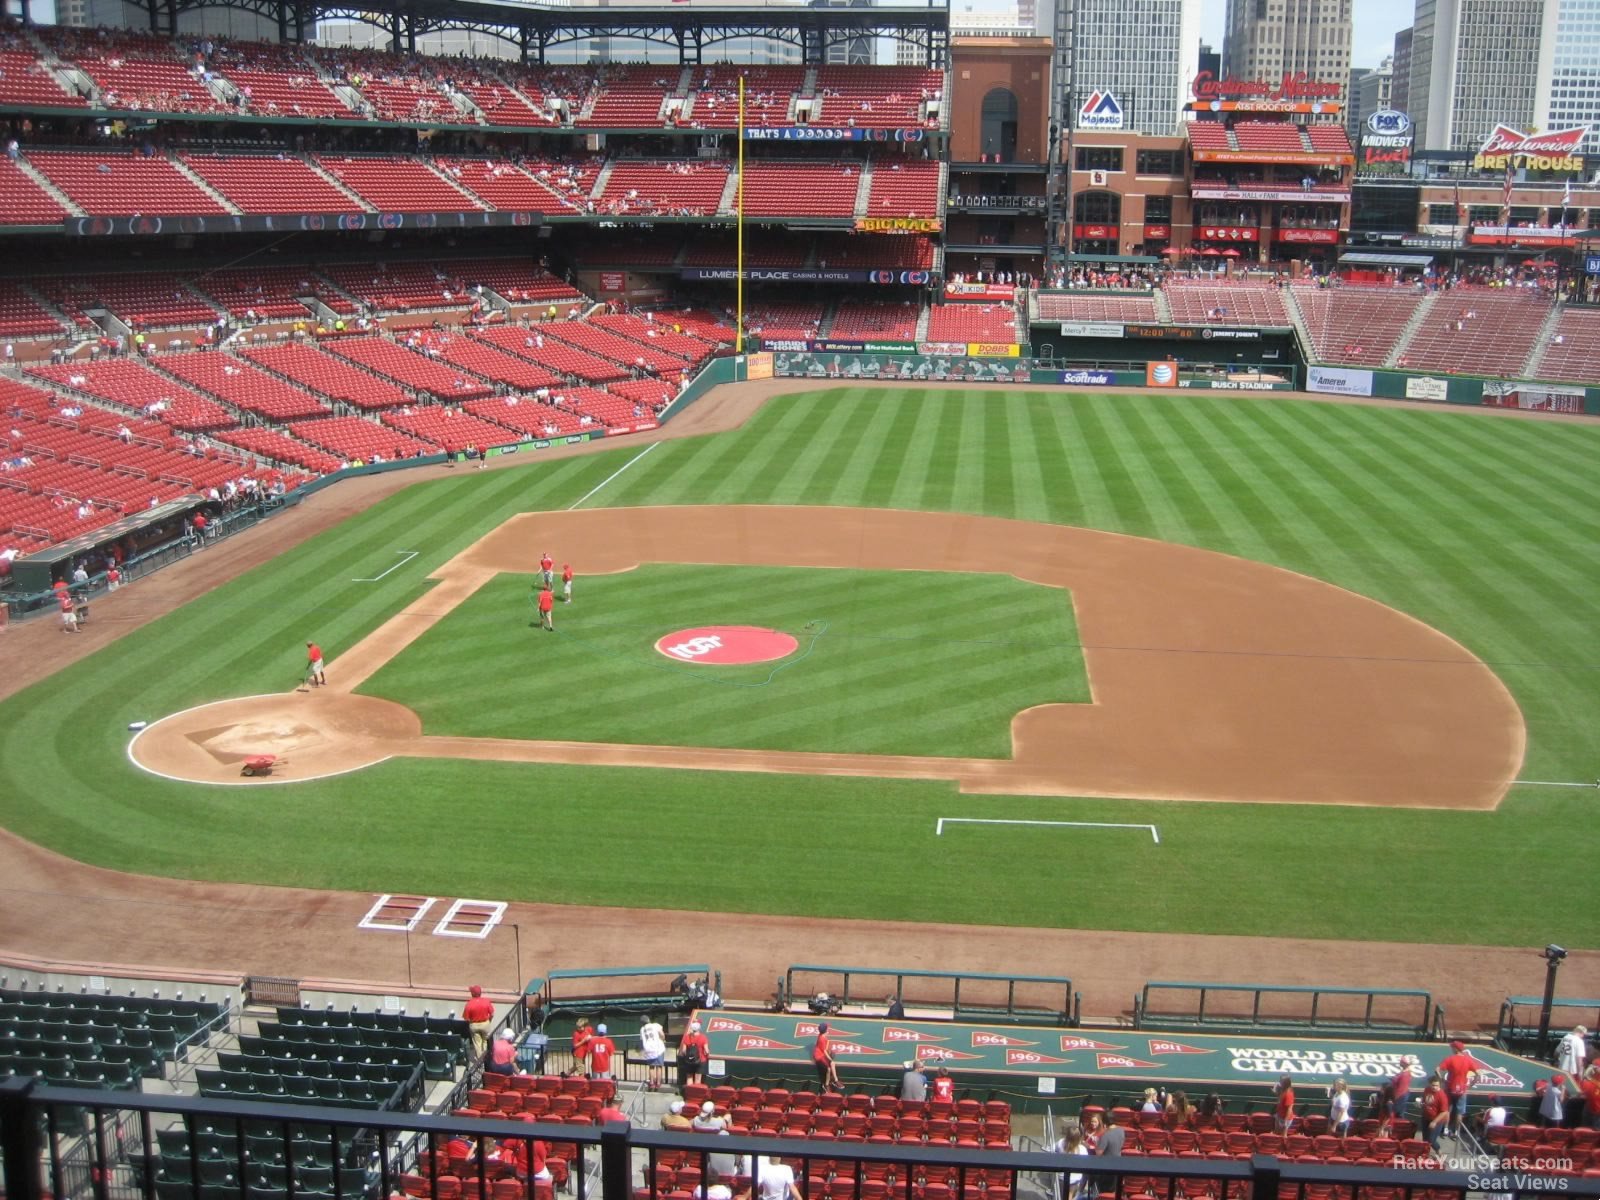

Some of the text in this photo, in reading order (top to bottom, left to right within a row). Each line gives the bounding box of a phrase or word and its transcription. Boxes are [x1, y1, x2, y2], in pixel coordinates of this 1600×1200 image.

[1191, 70, 1340, 100] Cardinals Nation
[1235, 102, 1297, 113] AT&T ROOFTOP
[1081, 114, 1121, 125] Majestic
[1376, 115, 1400, 126] FOX
[748, 128, 780, 139] THAT'S
[784, 128, 791, 139] A
[796, 128, 844, 139] POWER
[1361, 135, 1413, 147] MIDWEST
[1477, 132, 1583, 152] Budweiser
[1365, 148, 1409, 165] Live!
[1474, 154, 1584, 171] BREW HOUSE
[863, 219, 932, 231] BIG MAC
[751, 271, 789, 280] PLACE
[1064, 327, 1081, 335] Mercy
[1140, 328, 1164, 337] 12:00
[978, 344, 1009, 352] DOBBS
[1063, 371, 1108, 385] Scottrade
[1317, 376, 1347, 387] Ameren
[1211, 380, 1273, 390] BUSCH STADIUM
[712, 1020, 743, 1032] 1926
[799, 1026, 821, 1036] 193
[888, 1030, 920, 1041] 1944
[975, 1034, 1009, 1046] 1964
[742, 1038, 770, 1048] 1931
[831, 1042, 861, 1054] 1942
[1065, 1038, 1096, 1049] 1982
[1153, 1042, 1182, 1052] 2011
[921, 1047, 953, 1059] 1946
[1010, 1052, 1041, 1063] 1967
[1227, 1047, 1420, 1064] WORLD SERIES
[1100, 1056, 1135, 1067] 2006
[1231, 1057, 1428, 1078] CHAMPIONS
